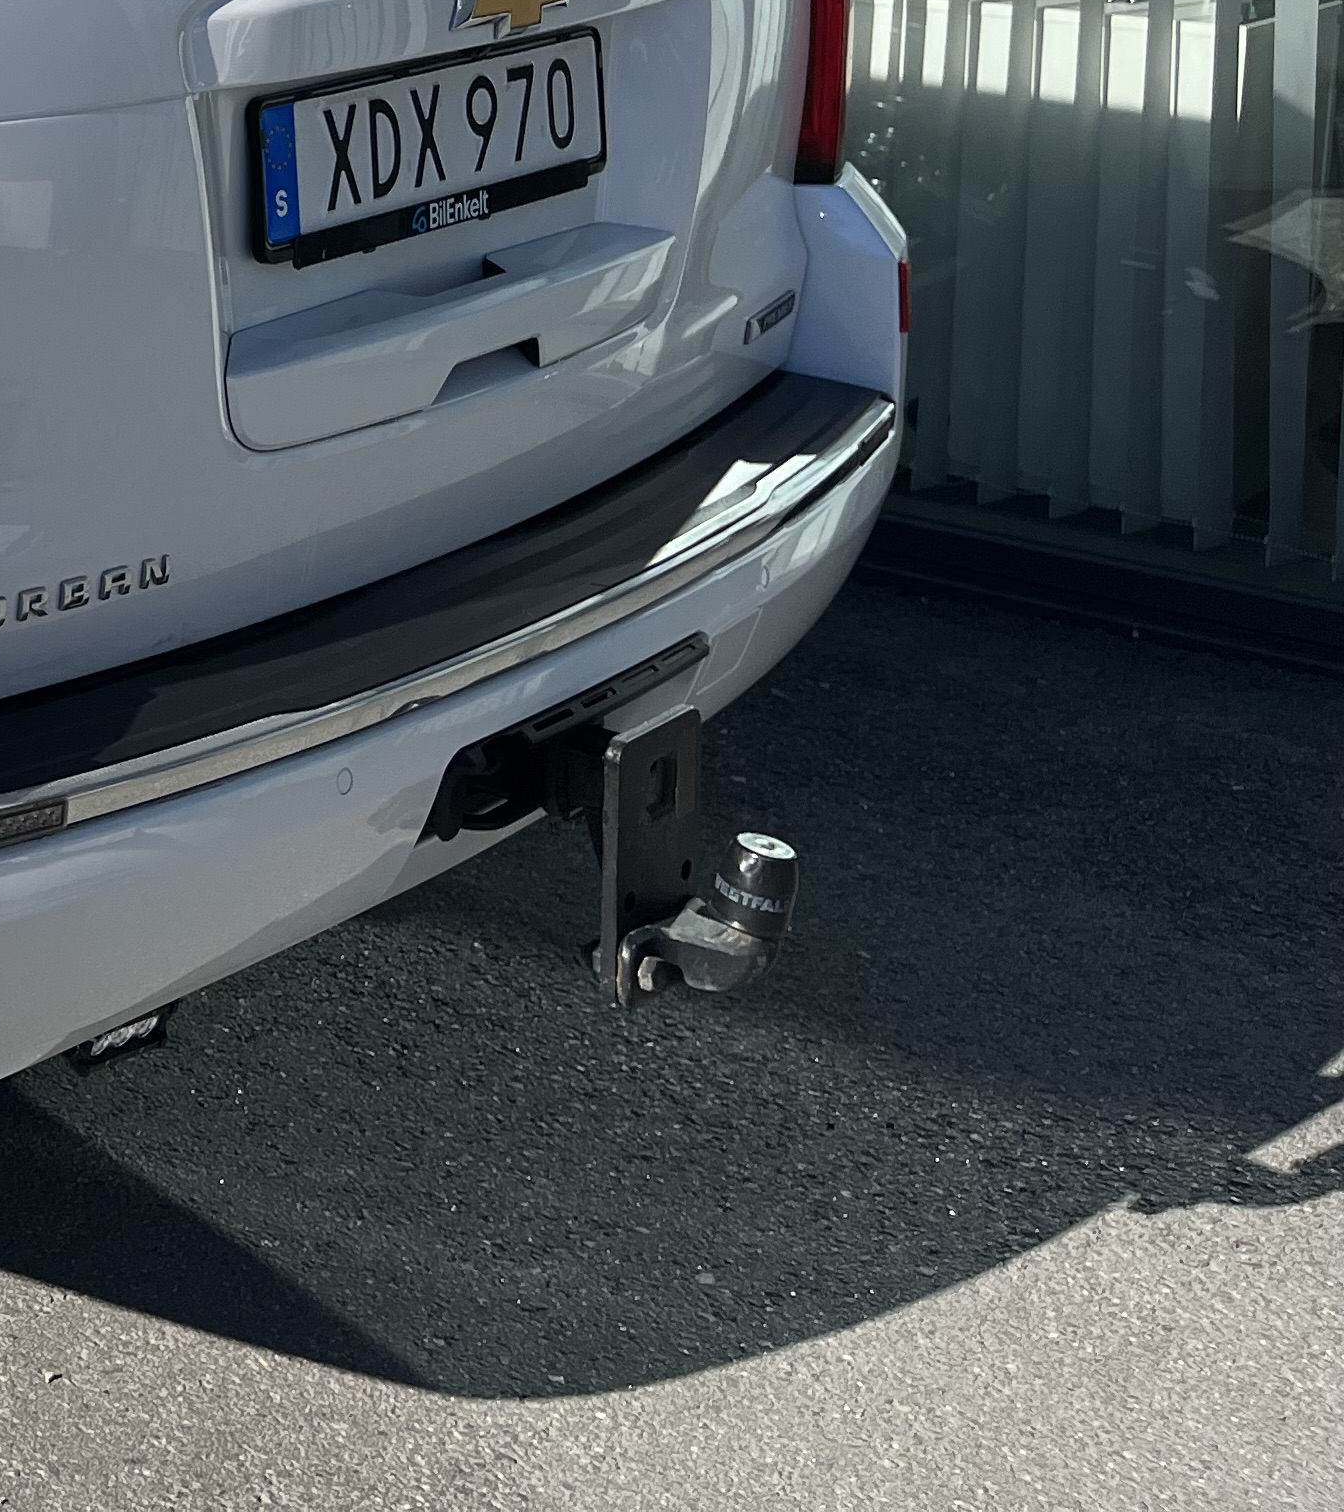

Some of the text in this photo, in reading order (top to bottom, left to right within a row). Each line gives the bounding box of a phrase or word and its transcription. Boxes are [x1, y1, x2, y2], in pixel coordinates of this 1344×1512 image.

[322, 58, 576, 212] XDX 970
[274, 189, 289, 219] S
[429, 189, 489, 230] BilEnkelt
